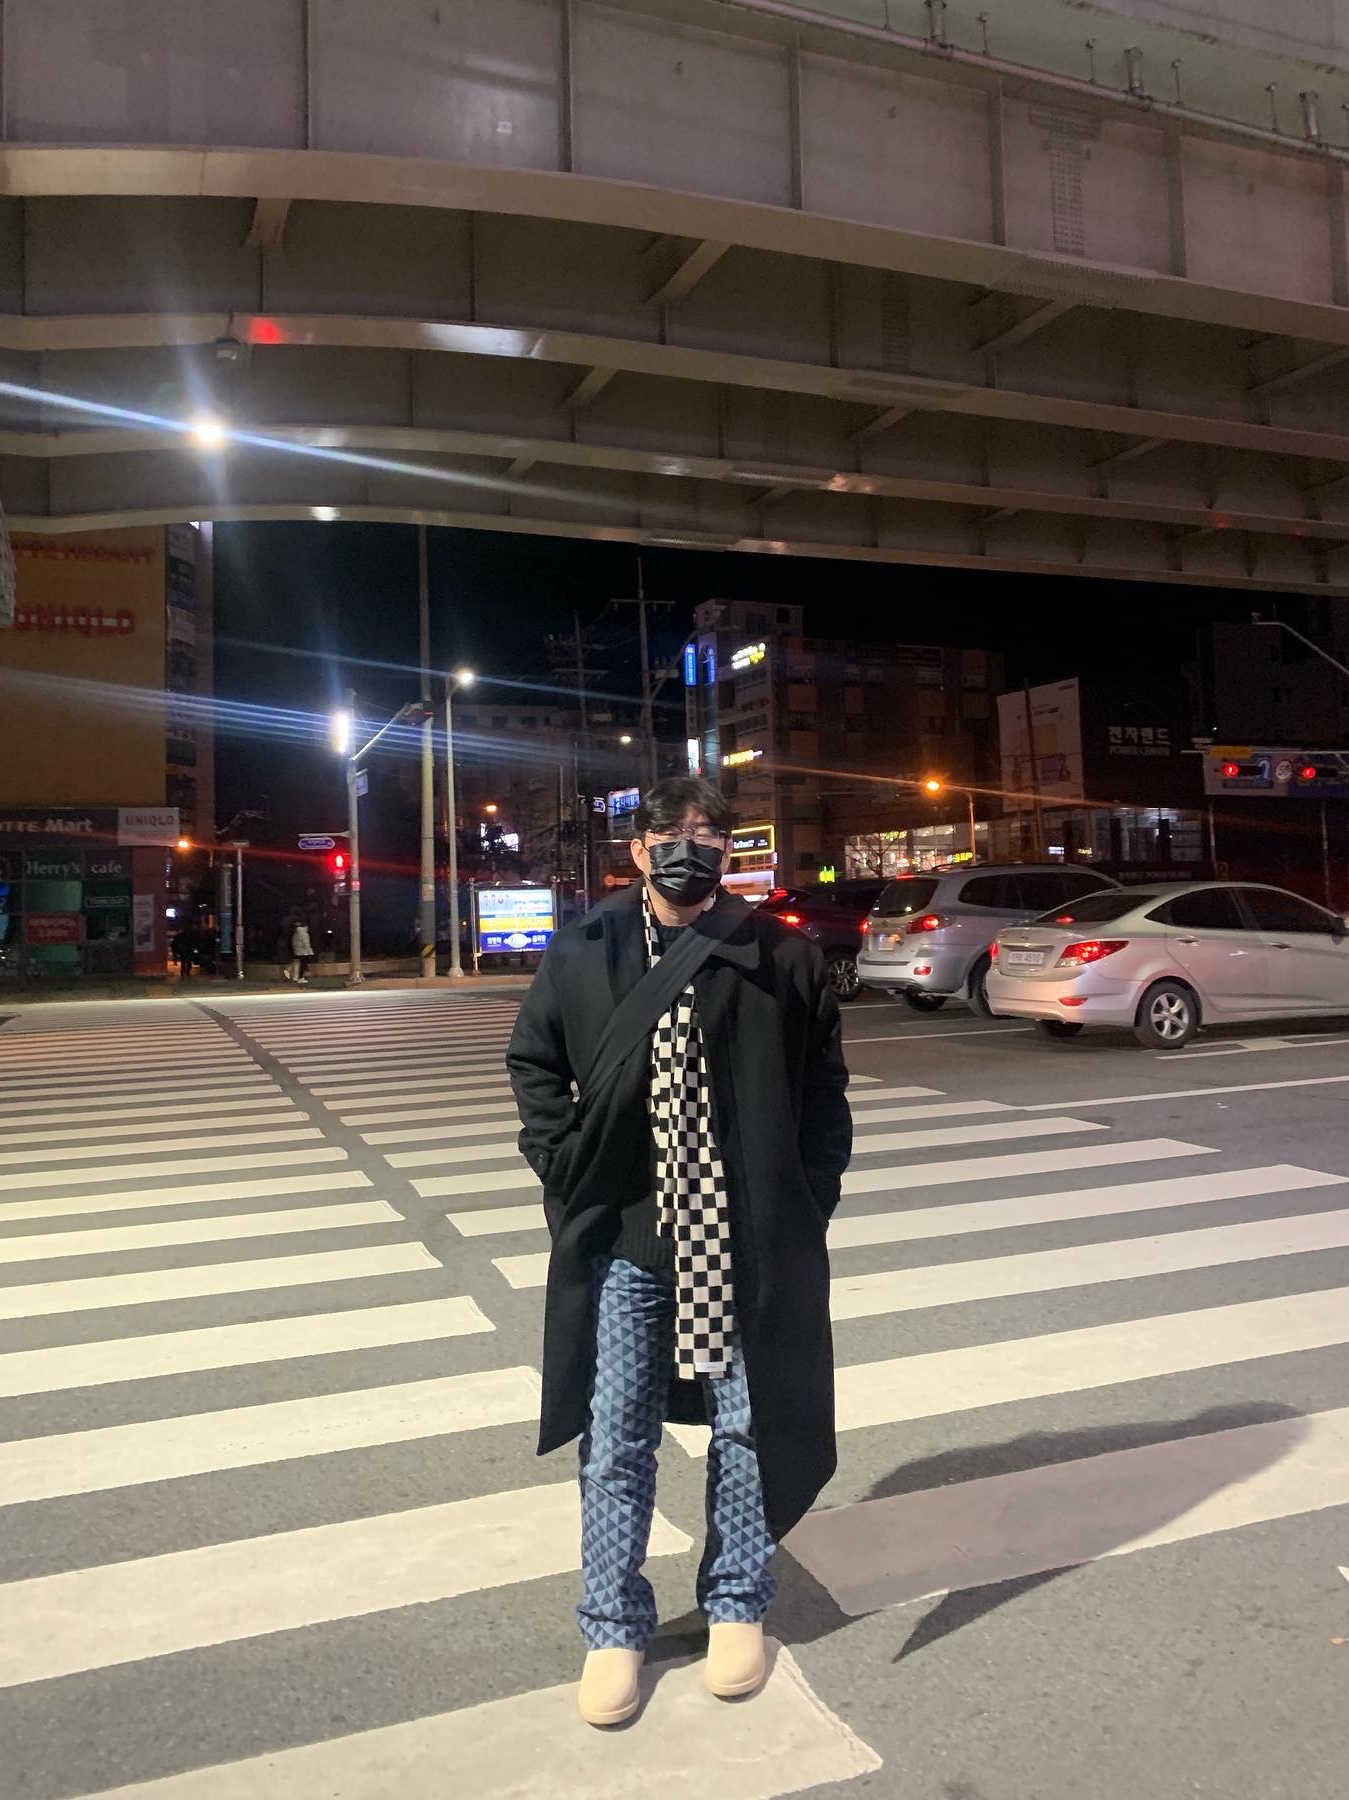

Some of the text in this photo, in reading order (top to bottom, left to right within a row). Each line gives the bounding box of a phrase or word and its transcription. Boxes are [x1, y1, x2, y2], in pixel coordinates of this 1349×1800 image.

[14, 606, 135, 636] UNIQLO
[1108, 725, 1171, 745] 전자랜드
[0, 818, 93, 833] TTE Mart
[125, 814, 174, 826] UNIQLO
[90, 860, 123, 875] cafe
